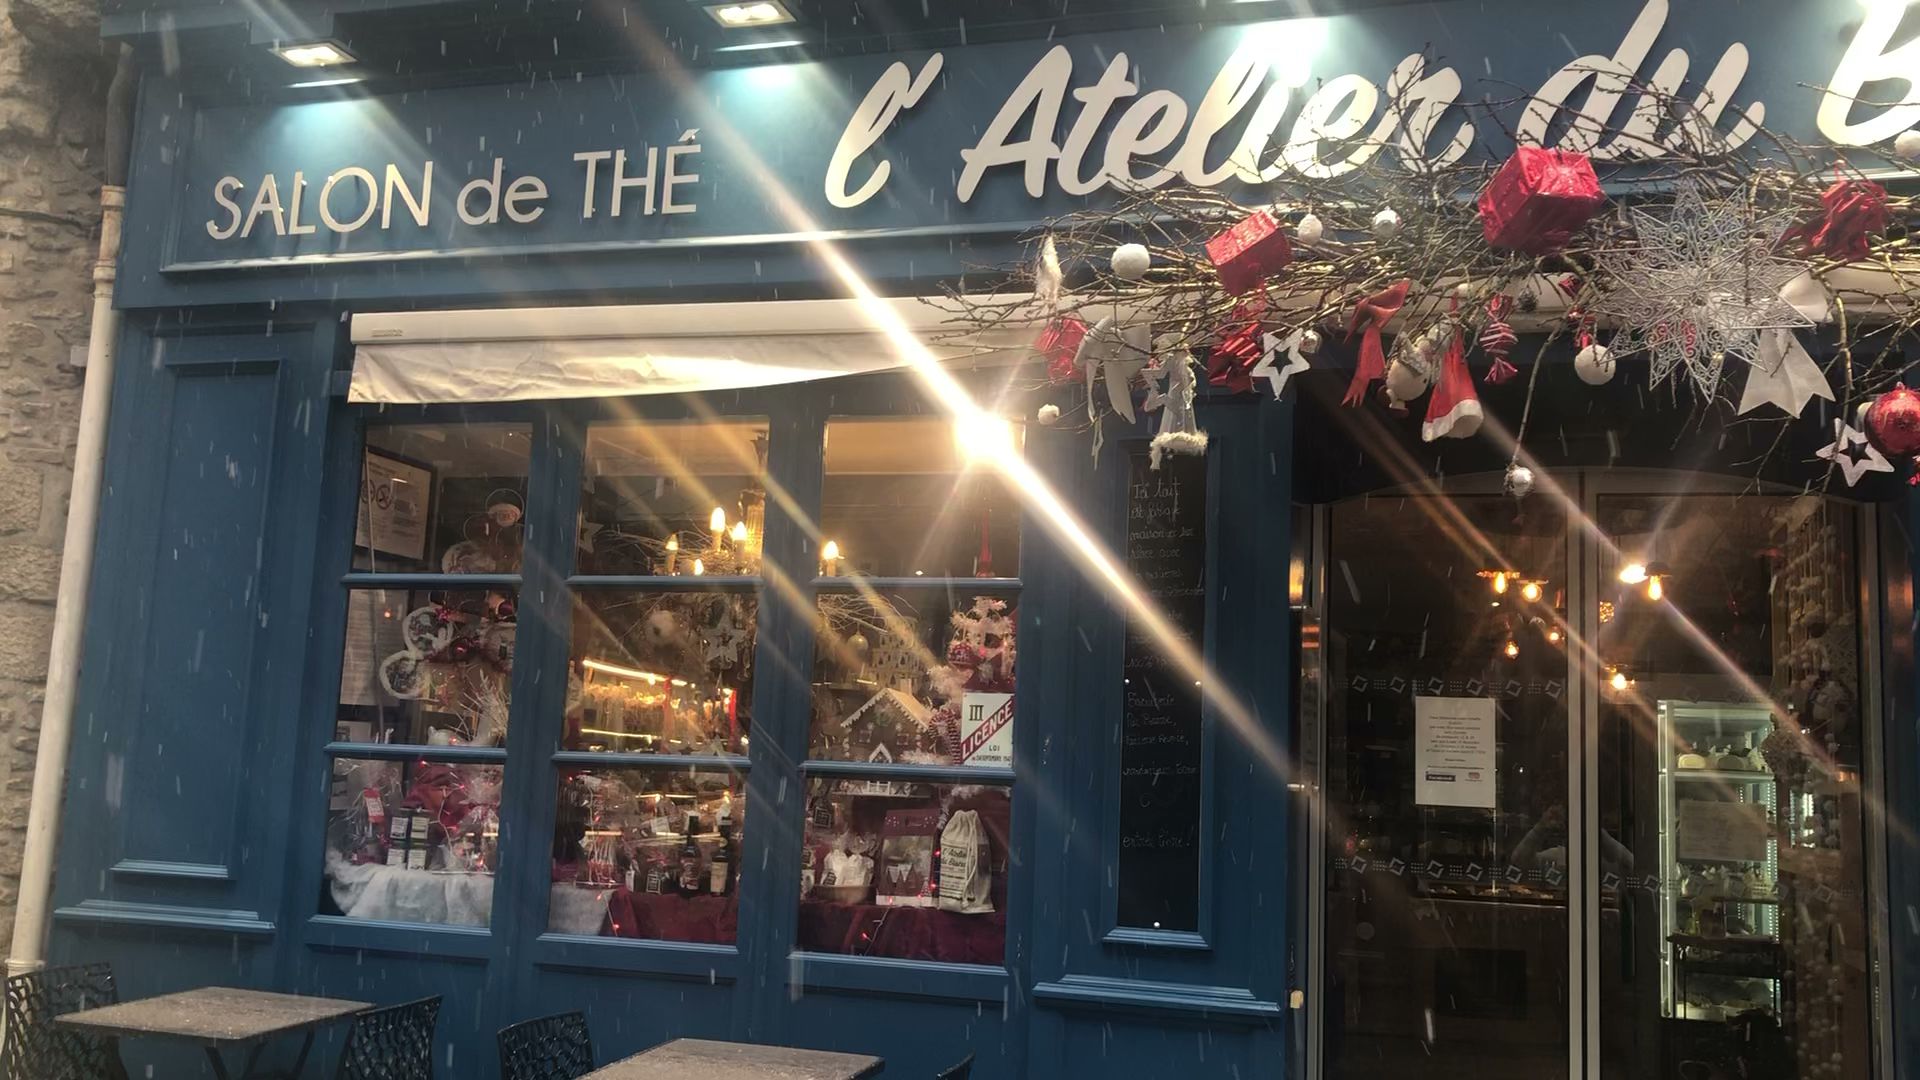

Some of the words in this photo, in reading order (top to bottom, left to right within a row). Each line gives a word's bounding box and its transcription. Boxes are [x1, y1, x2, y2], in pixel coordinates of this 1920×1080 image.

[956, 44, 1474, 203] Atelier
[1516, 0, 1765, 159] du
[206, 161, 434, 240] SALON
[456, 157, 549, 226] de
[573, 128, 702, 218] THÉ
[963, 700, 1013, 760] LICENCE
[969, 704, 984, 721] III
